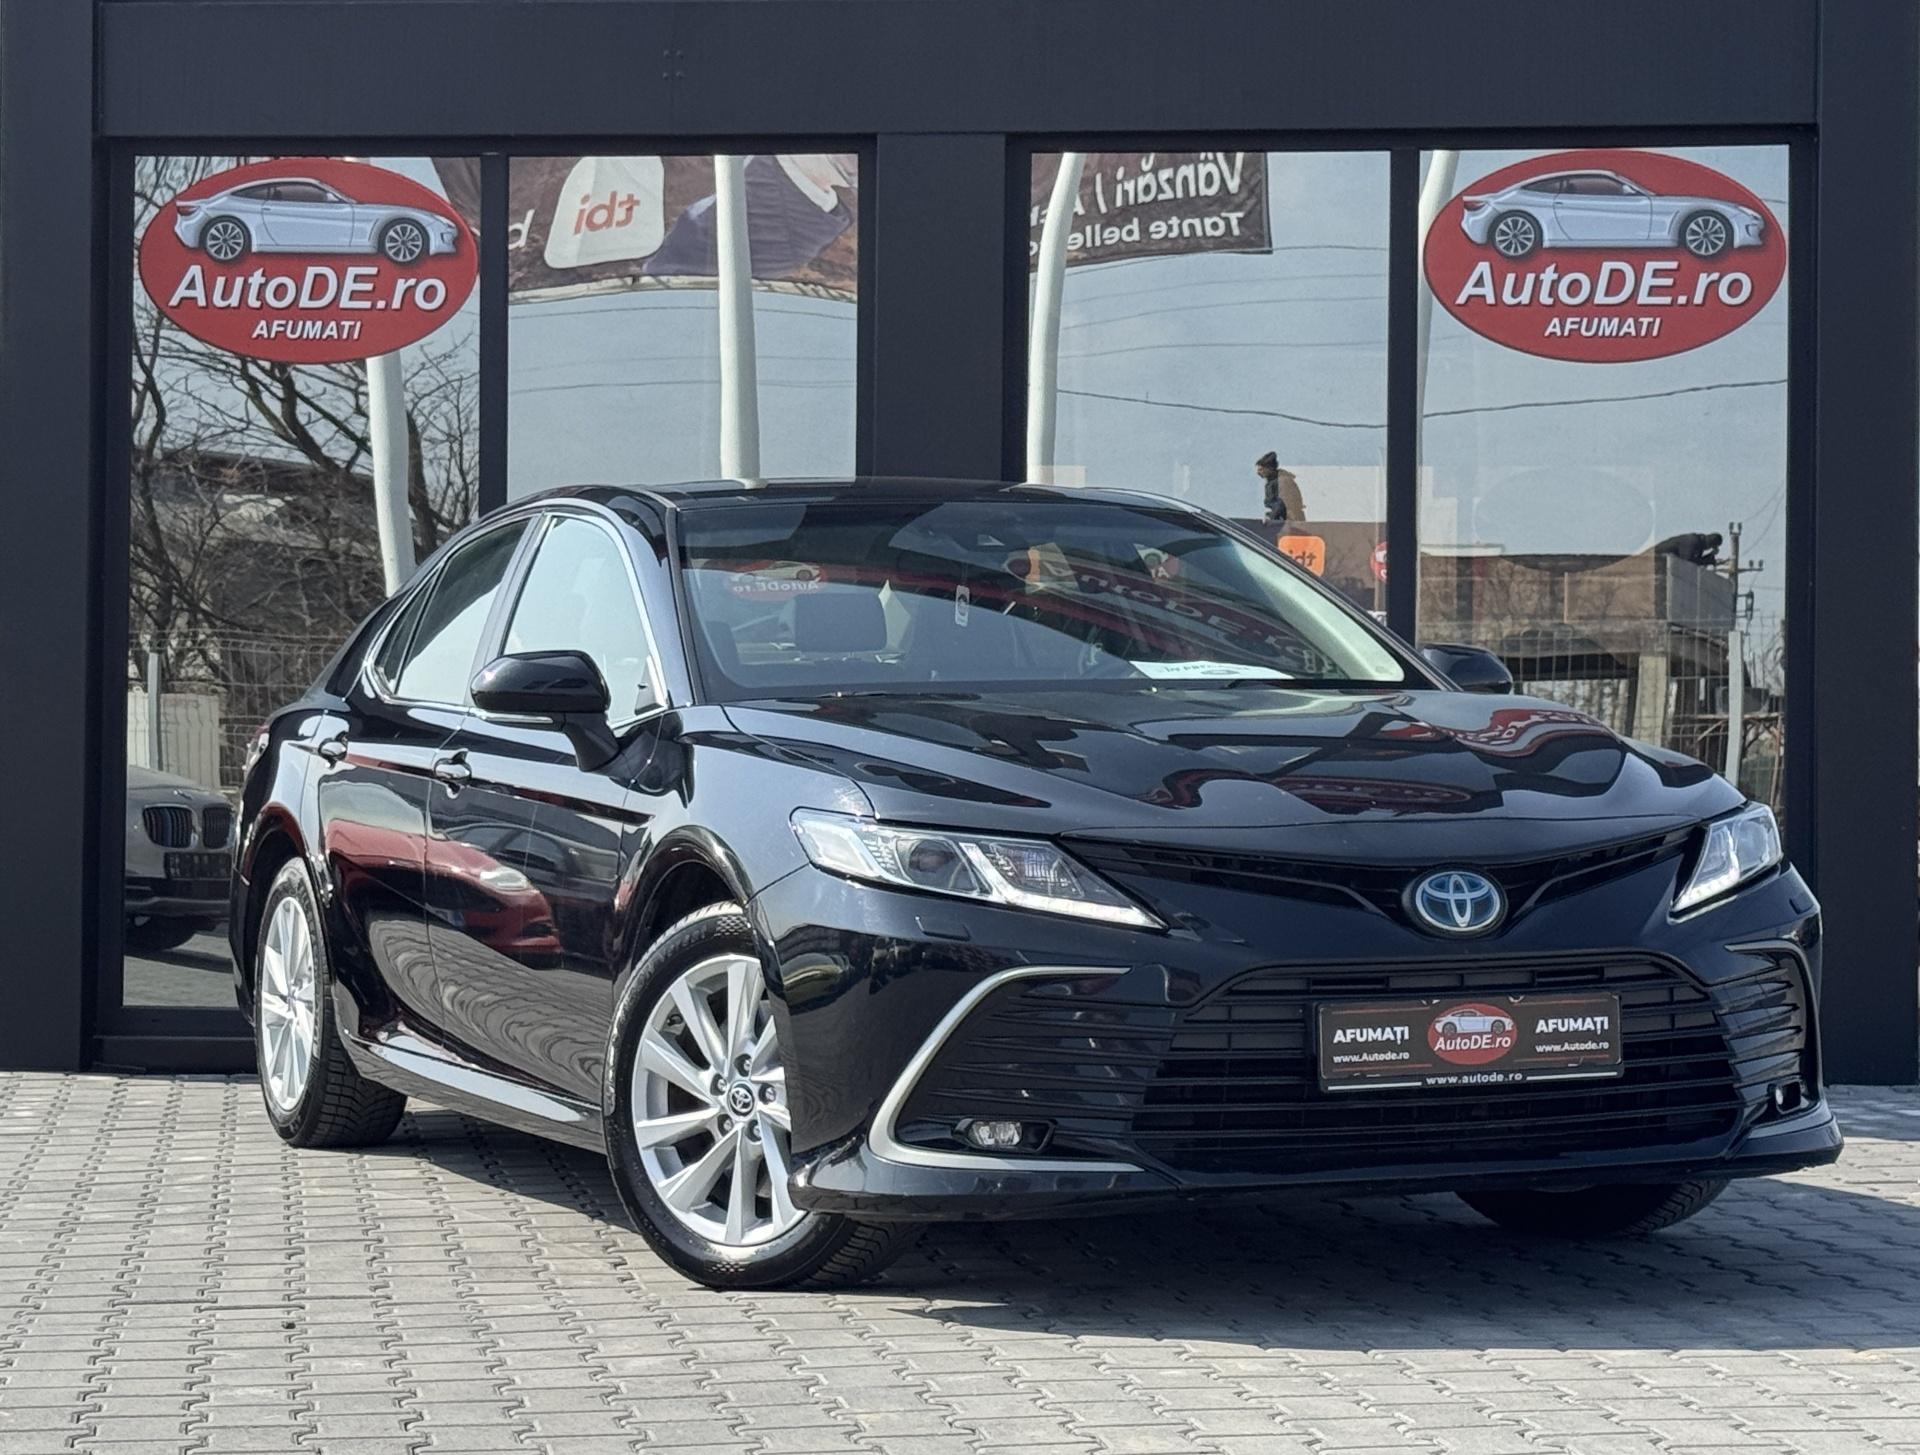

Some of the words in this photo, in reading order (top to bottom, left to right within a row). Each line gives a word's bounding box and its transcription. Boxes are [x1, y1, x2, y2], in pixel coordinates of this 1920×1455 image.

[168, 264, 447, 311] AutoDE.ro
[1455, 260, 1753, 307] AutoDE.ro
[252, 319, 362, 340] AFUMATI
[1544, 316, 1662, 338] AFUMATI
[1433, 1034, 1511, 1051] AutoDE.ro
[1535, 1041, 1610, 1053] www.Autode.ro
[1332, 1051, 1410, 1063] www.Autode.ro
[1426, 1072, 1523, 1085] www.autode.ro
